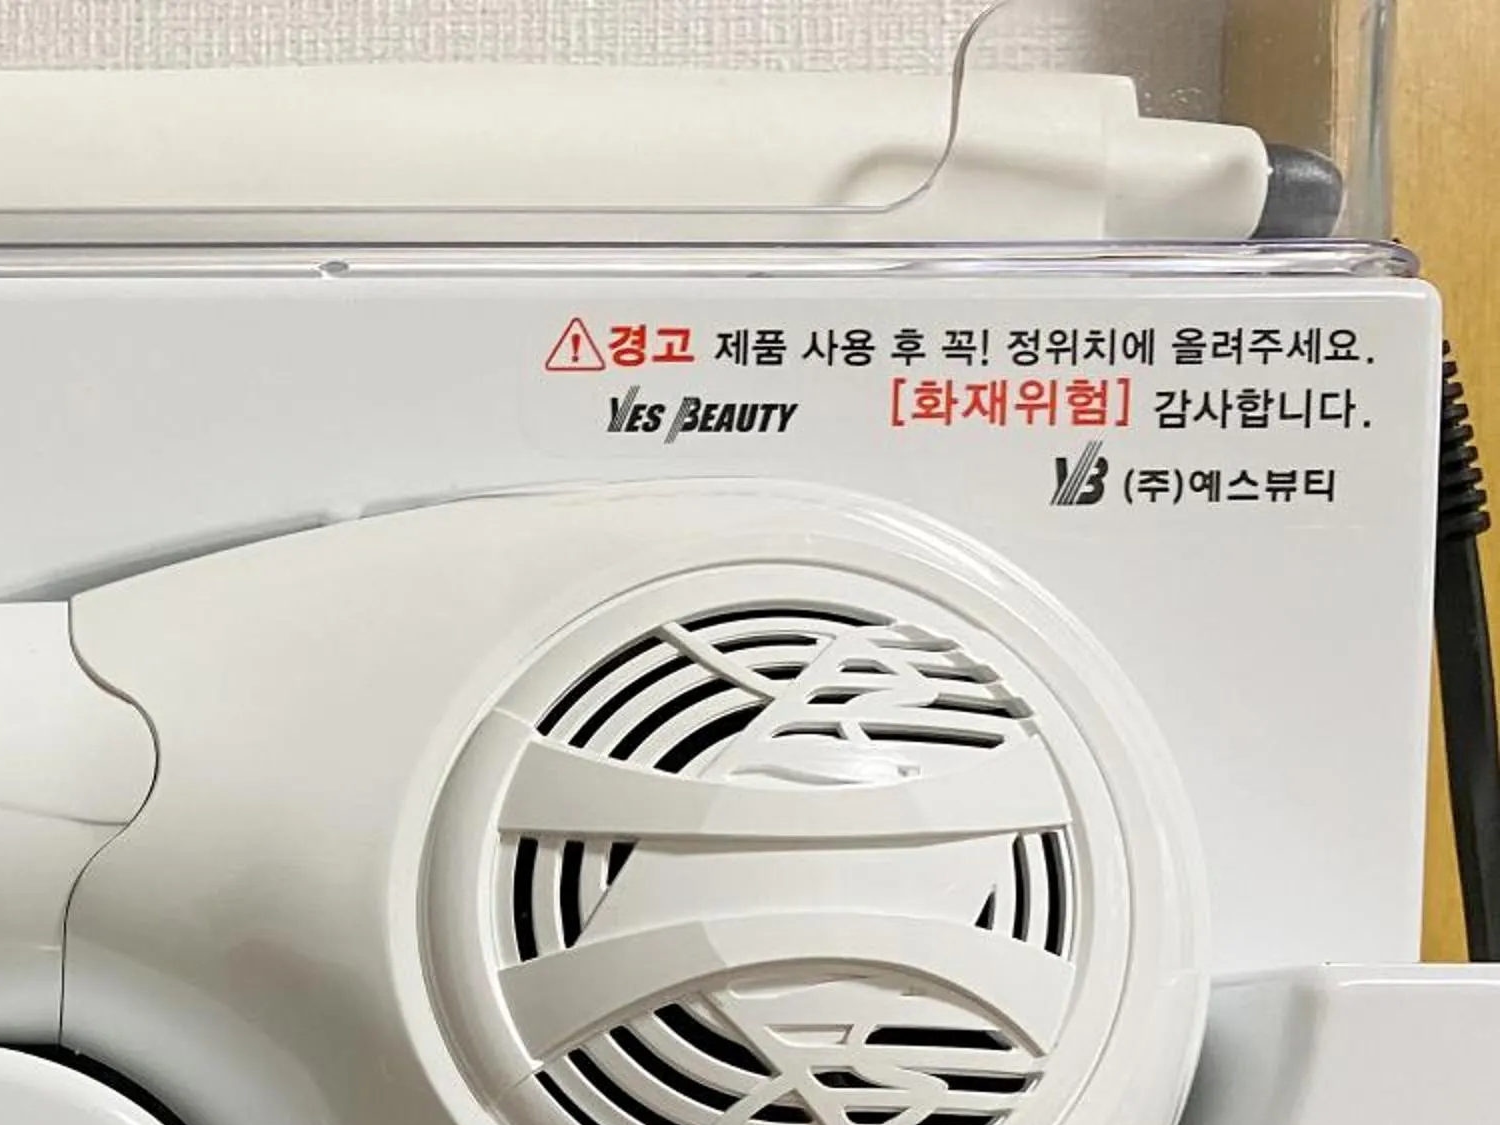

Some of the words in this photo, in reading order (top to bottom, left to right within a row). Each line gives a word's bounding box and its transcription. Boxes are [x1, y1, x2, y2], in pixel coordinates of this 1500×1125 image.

[608, 324, 694, 368] 경고
[715, 328, 786, 368] 제품
[803, 328, 874, 367] 사용
[890, 328, 926, 367] 후
[942, 328, 990, 367] 꼭!
[1007, 328, 1156, 366] 정위치에
[1171, 327, 1375, 366] 올려주세요.
[607, 386, 665, 432] YES
[665, 397, 797, 443] BEAUTY
[891, 377, 1132, 428] [화재위험]
[1154, 387, 1372, 429] 감사합니다.
[1125, 467, 1336, 505] (주)예스뷰티
